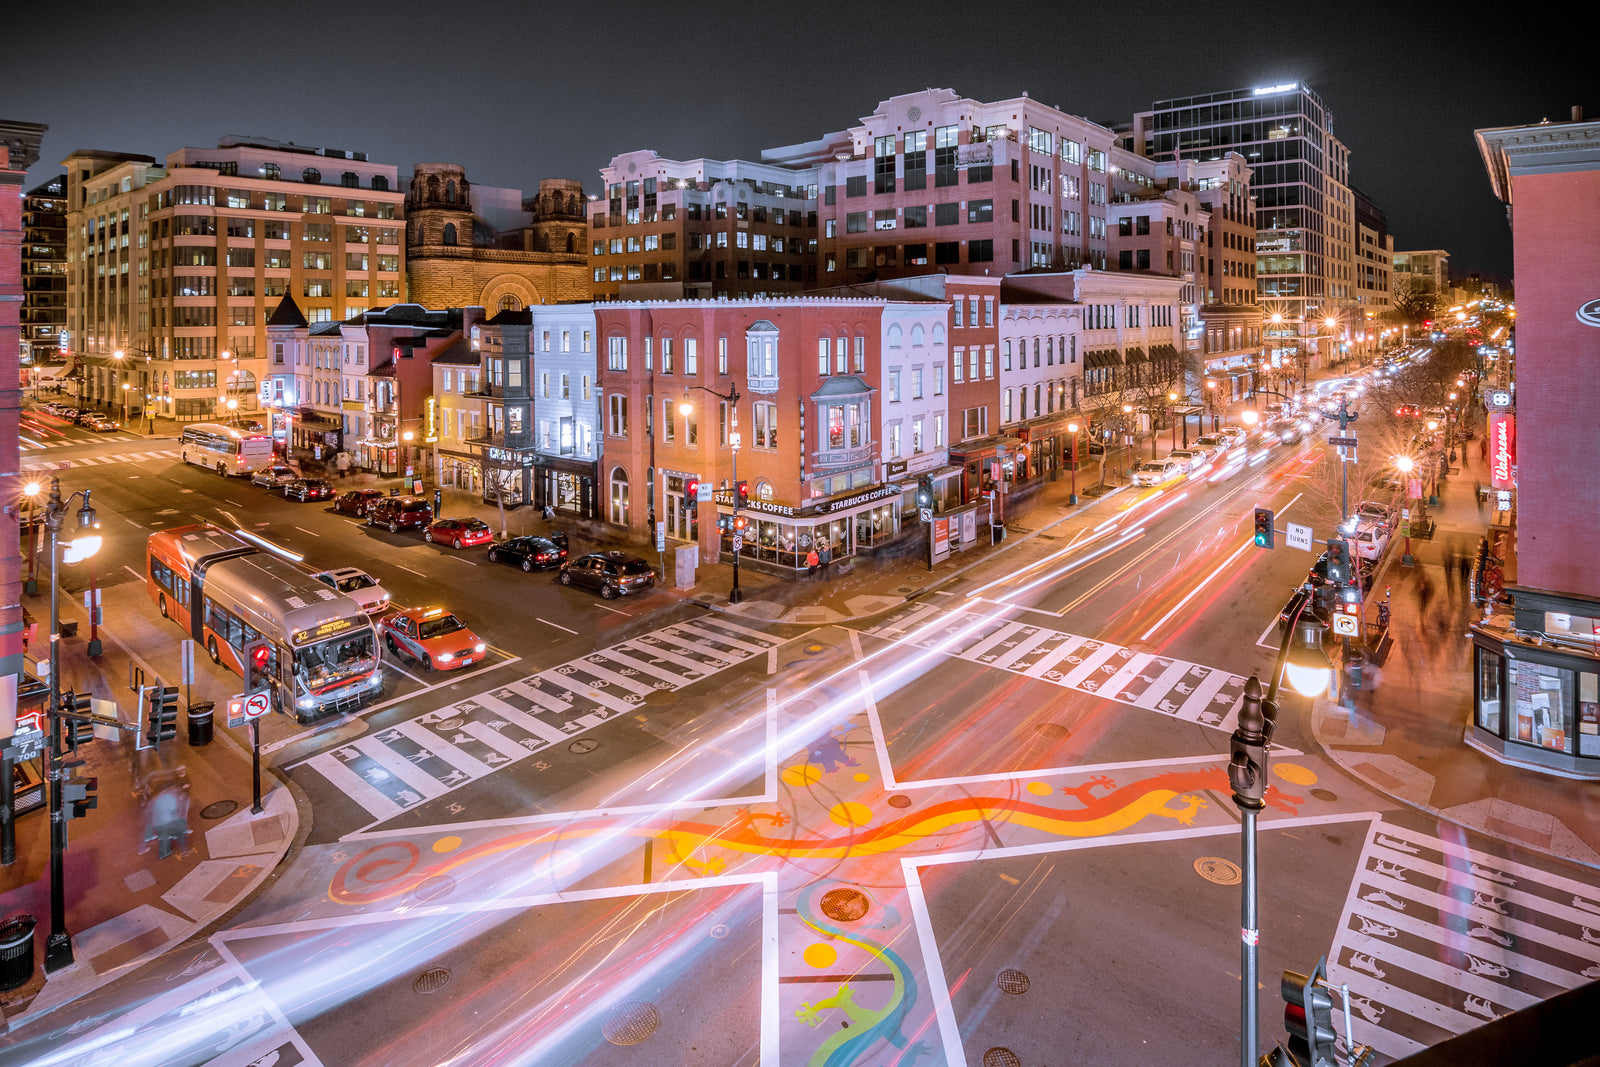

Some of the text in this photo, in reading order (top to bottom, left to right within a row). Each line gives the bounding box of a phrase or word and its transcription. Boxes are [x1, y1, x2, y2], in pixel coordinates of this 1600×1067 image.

[1496, 420, 1511, 481] Walgreens
[830, 487, 892, 511] STARBUCKS COFFEE
[762, 503, 794, 516] COFFEE
[1295, 527, 1304, 535] NO
[1289, 534, 1308, 545] TURNS
[297, 631, 308, 640] X2
[20, 743, 29, 754] 7
[17, 751, 36, 761] 700
